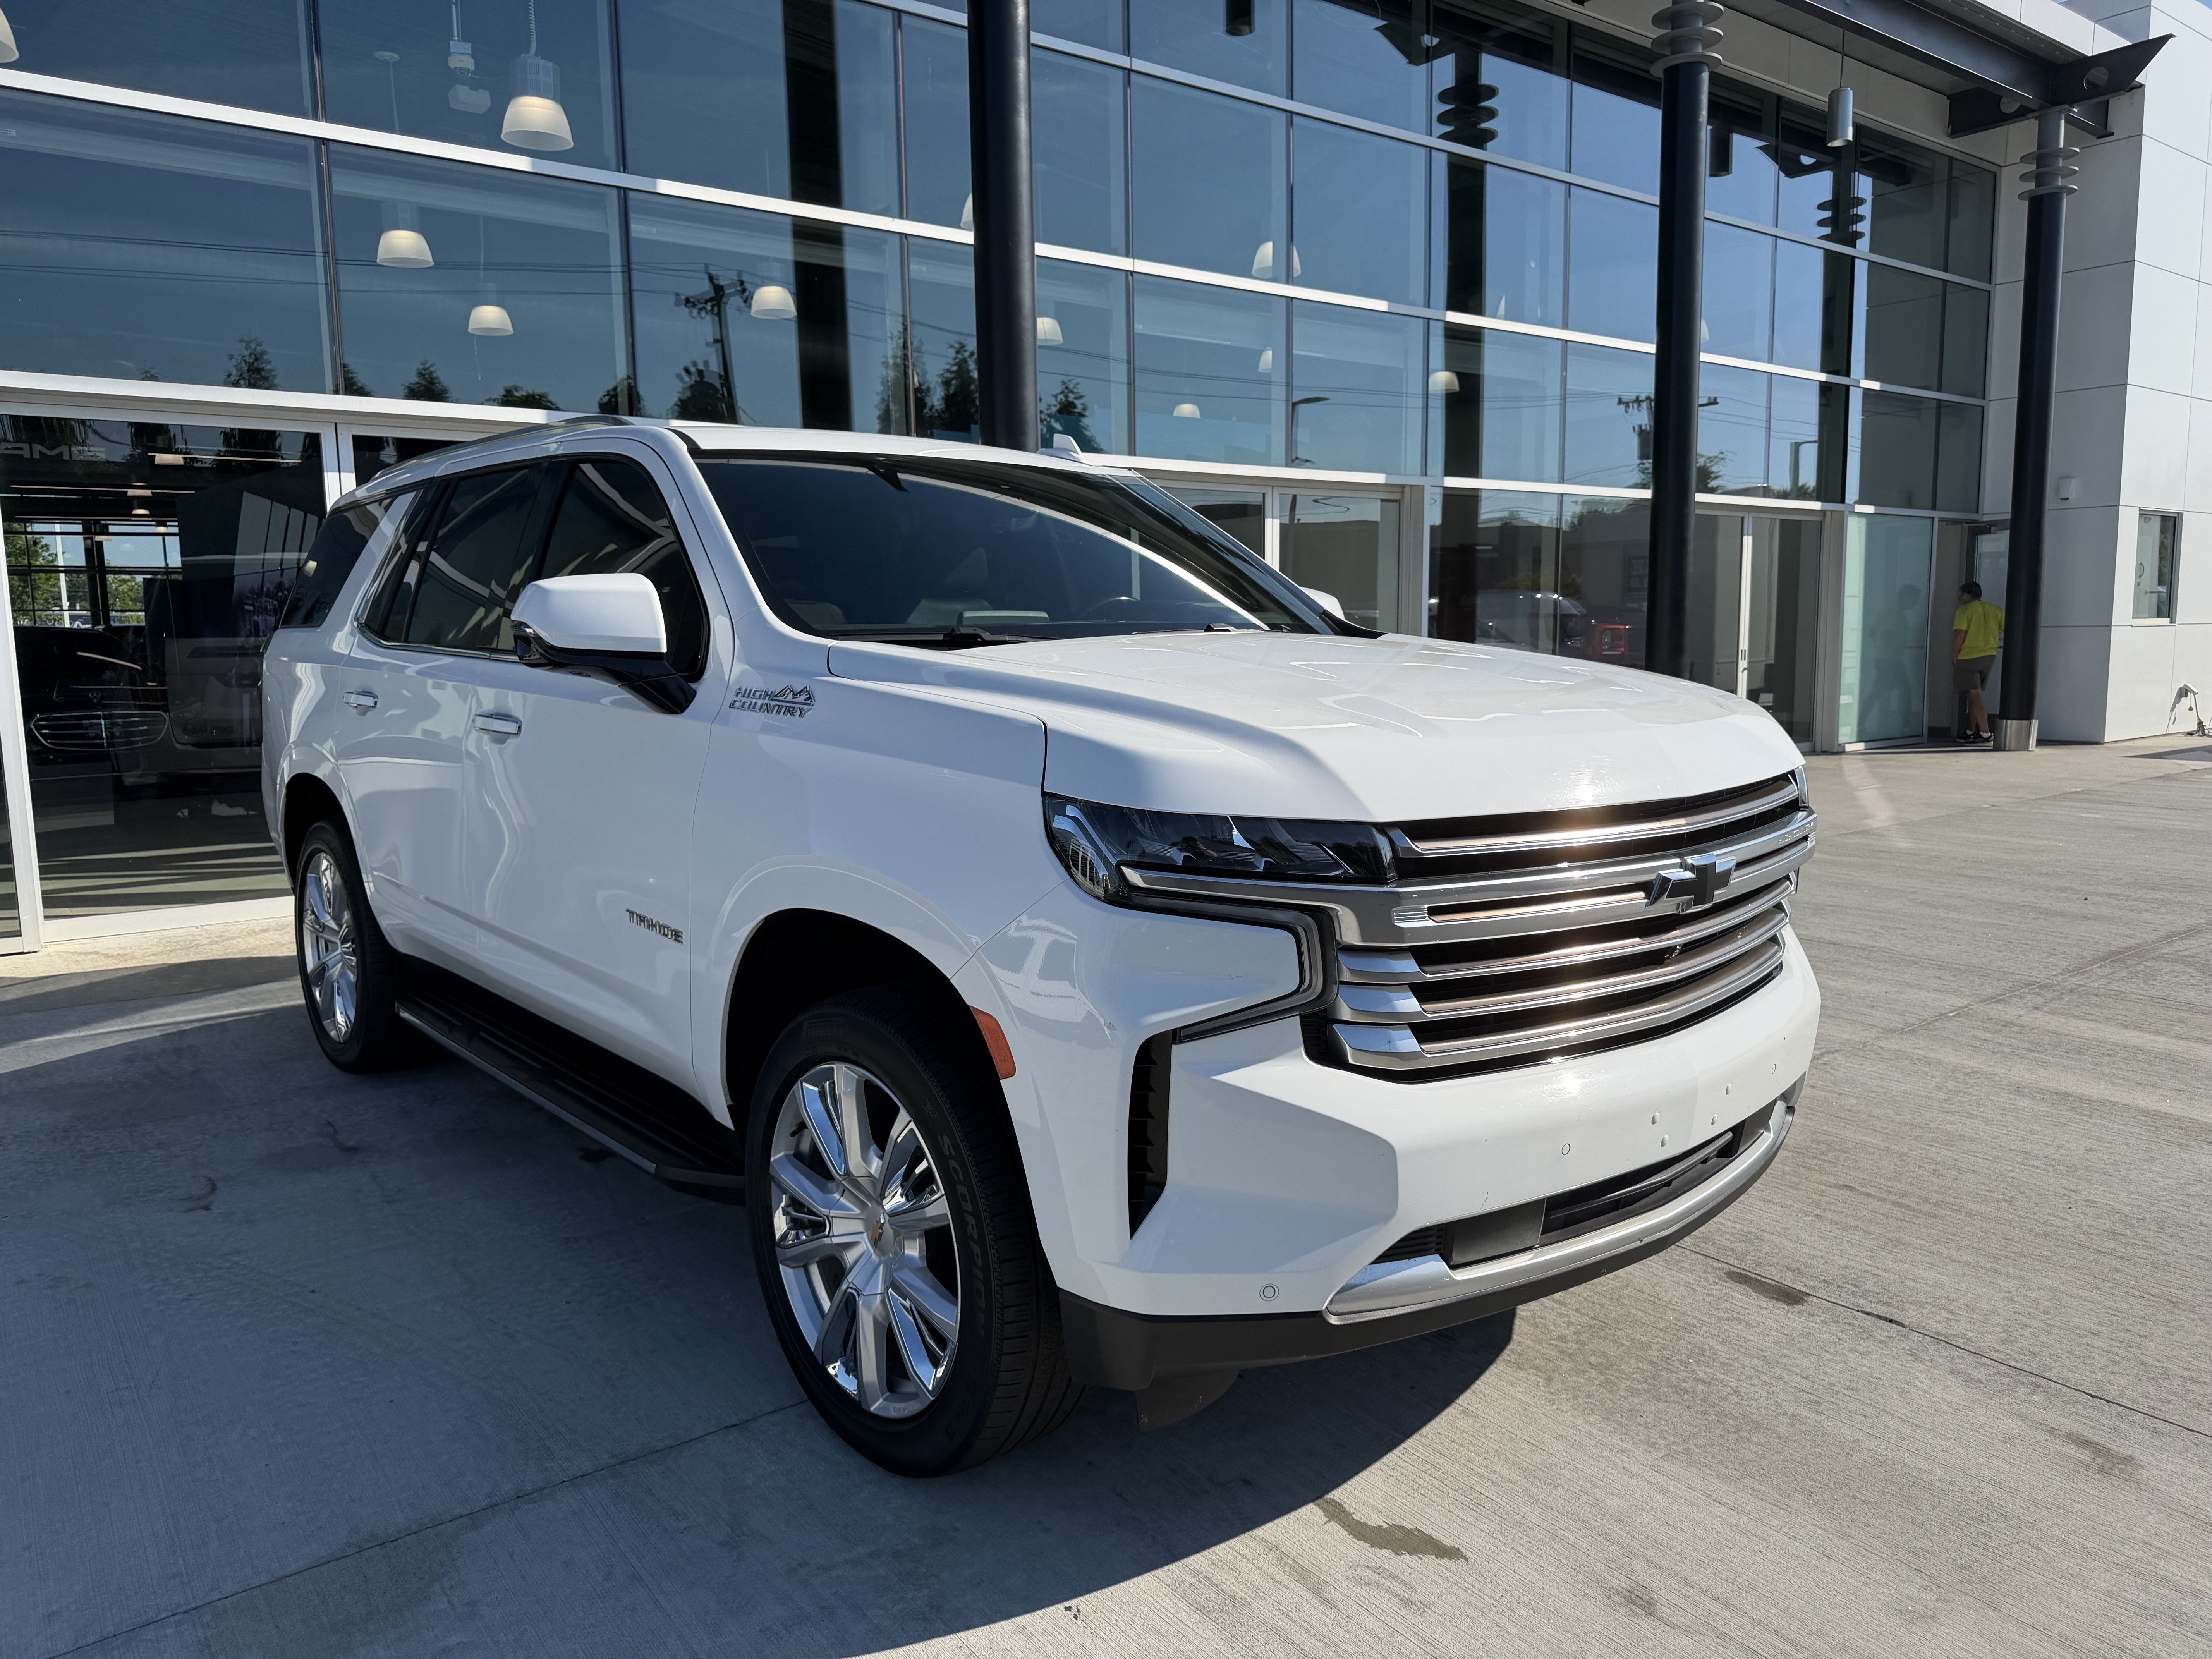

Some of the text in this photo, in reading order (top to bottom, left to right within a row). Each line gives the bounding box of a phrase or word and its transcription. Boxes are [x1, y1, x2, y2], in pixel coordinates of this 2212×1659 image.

[734, 685, 776, 701] HIGH
[729, 698, 812, 719] COUNTRY
[625, 908, 684, 945] TAHOE
[802, 1017, 845, 1039] PIRELLI
